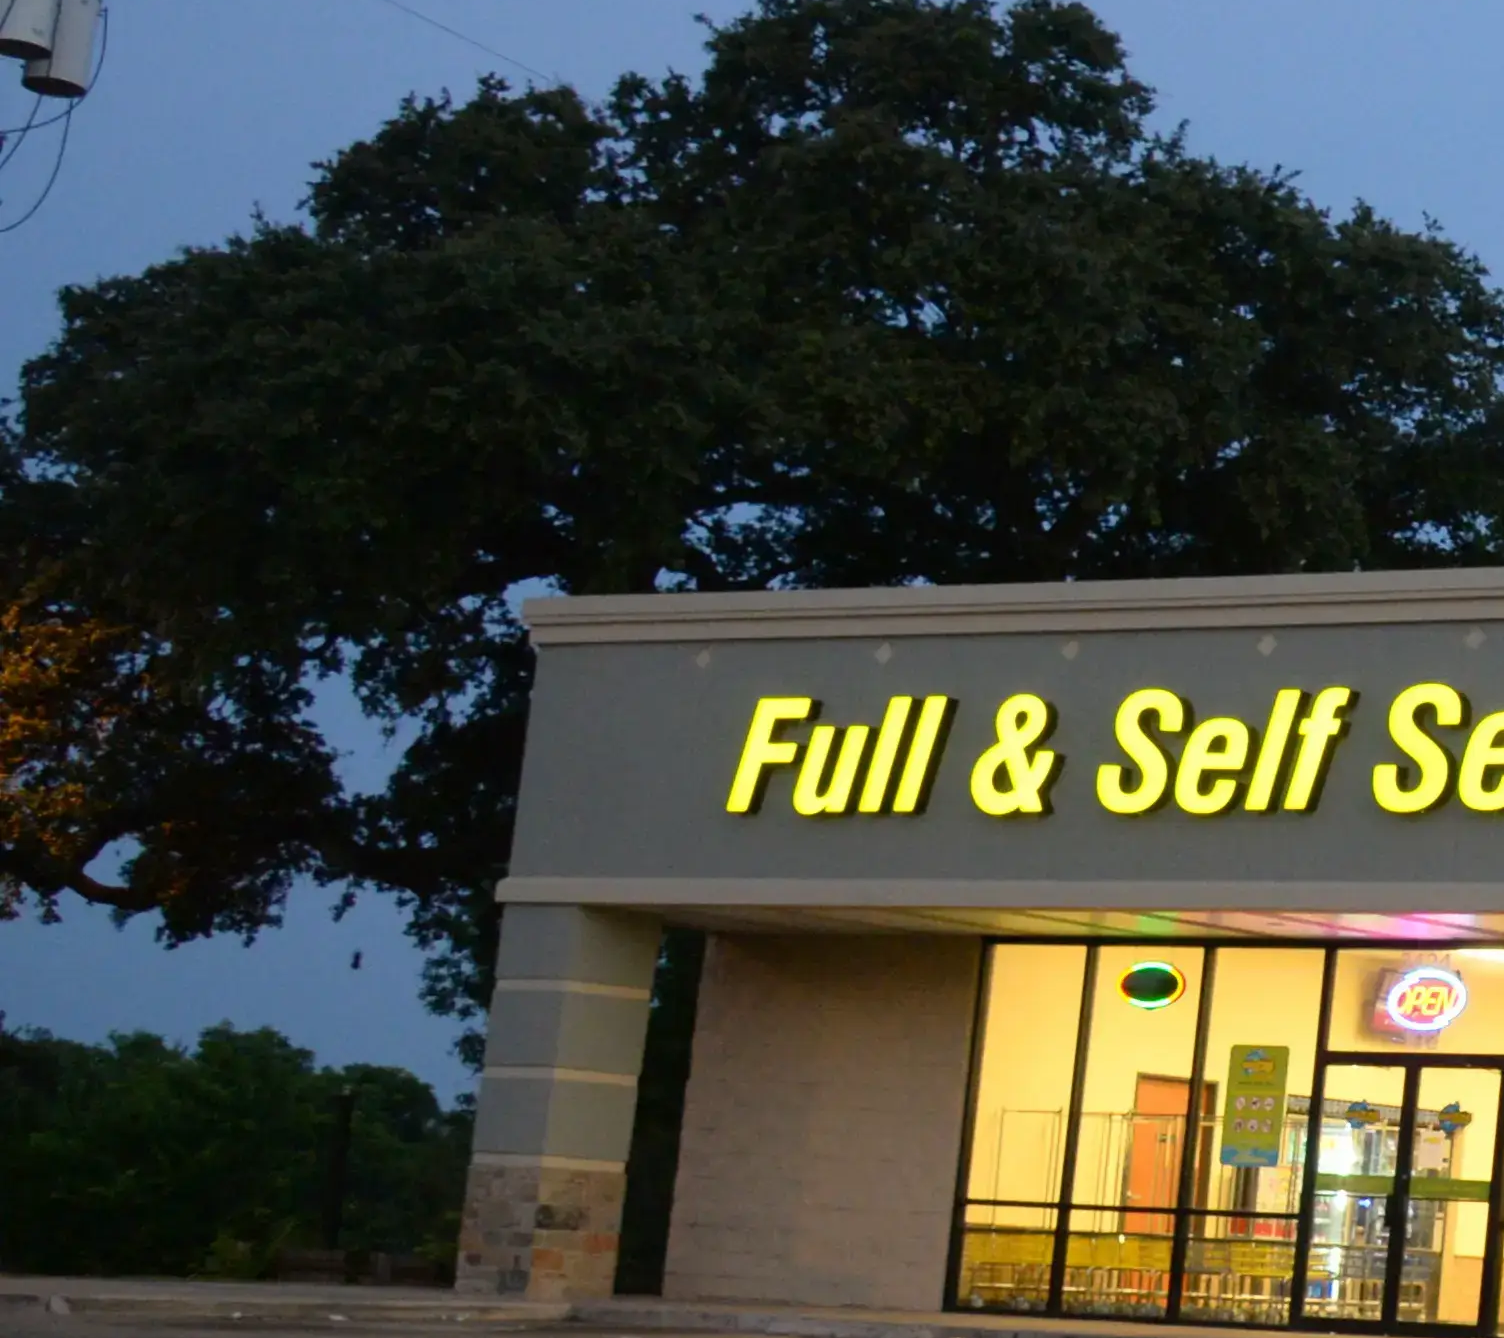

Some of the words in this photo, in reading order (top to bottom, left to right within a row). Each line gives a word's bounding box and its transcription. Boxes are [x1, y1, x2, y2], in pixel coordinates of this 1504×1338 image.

[727, 694, 947, 815] Full
[971, 694, 1054, 815] &
[1097, 687, 1350, 813] Self
[1395, 985, 1457, 1016] OPEN
